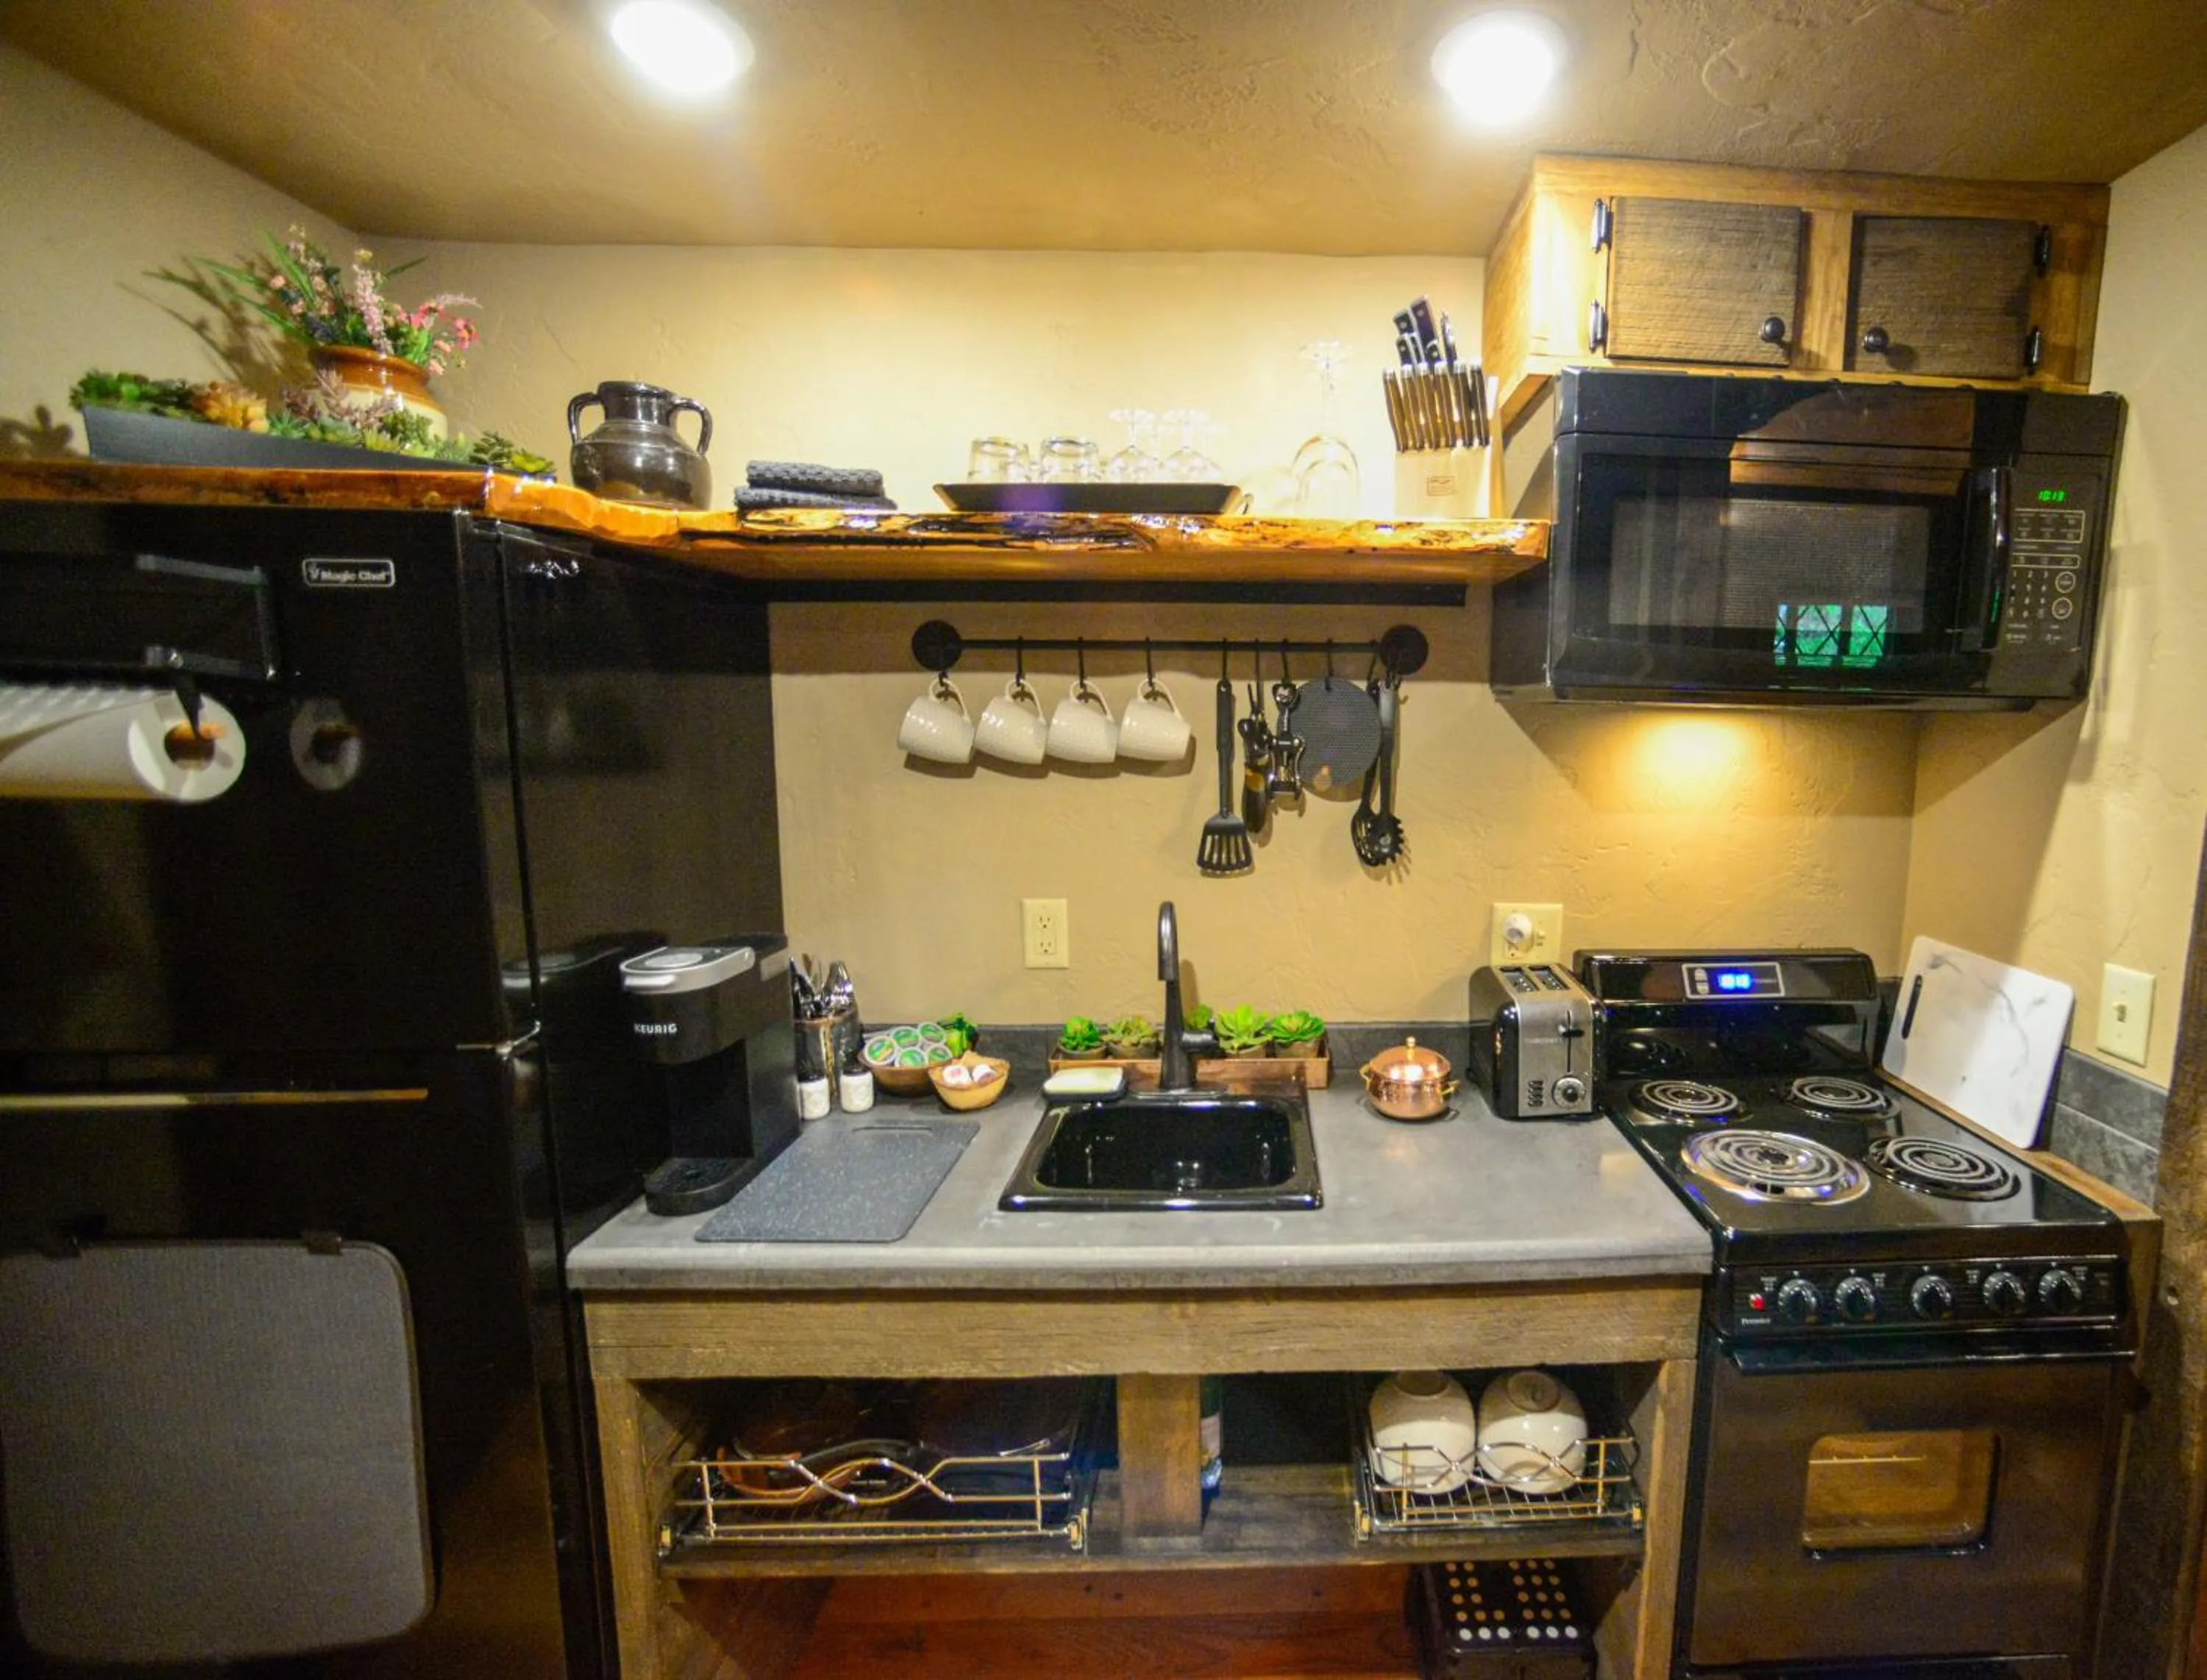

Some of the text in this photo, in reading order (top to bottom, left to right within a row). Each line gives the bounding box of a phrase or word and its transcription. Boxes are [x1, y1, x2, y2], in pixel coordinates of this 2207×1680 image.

[321, 569, 386, 583] Magic Chef
[633, 1023, 678, 1034] KEURIG
